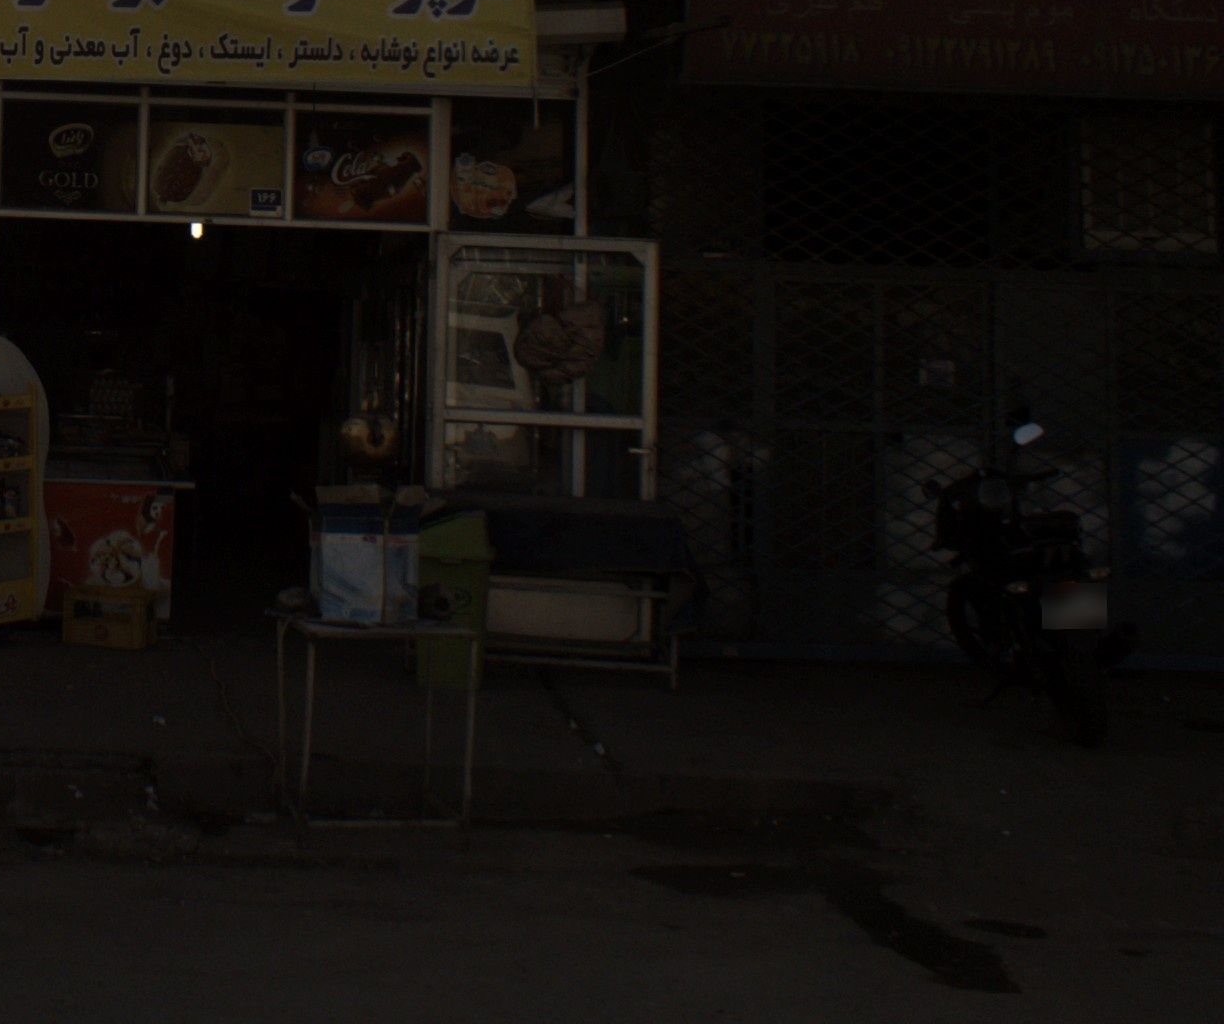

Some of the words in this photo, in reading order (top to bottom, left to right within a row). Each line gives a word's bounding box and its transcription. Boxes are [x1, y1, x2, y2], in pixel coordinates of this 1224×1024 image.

[0, 26, 29, 65] آب
[33, 38, 45, 66] و
[49, 34, 106, 66] معدنی
[111, 27, 141, 66] آب
[157, 33, 193, 75] دوغ
[210, 33, 271, 68] ایستک
[288, 37, 343, 69] دلستر
[360, 36, 419, 71] نوشابه
[423, 39, 467, 78] انواع
[471, 40, 520, 72] عرضه
[36, 170, 100, 189] GOLD
